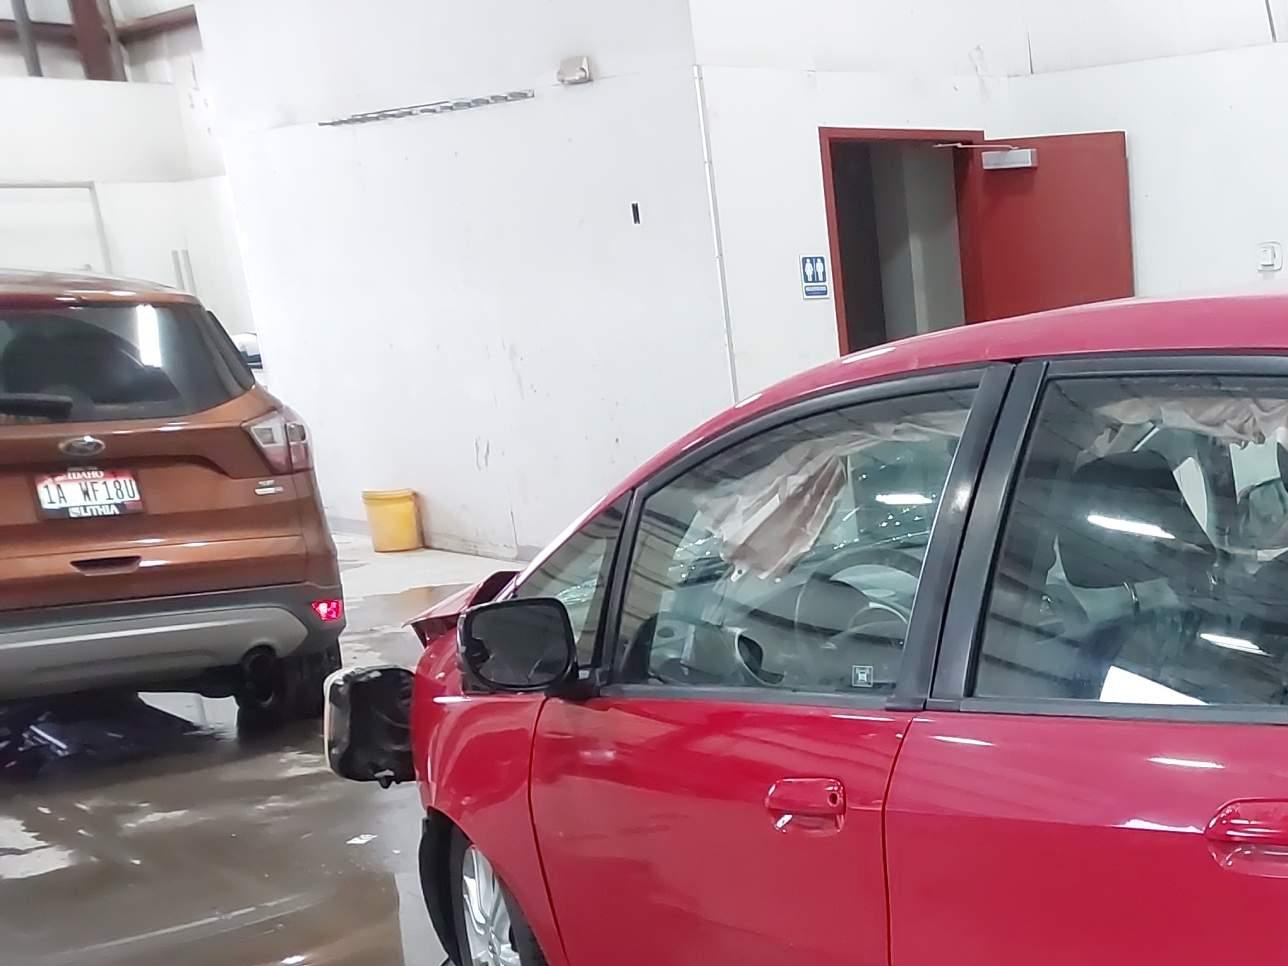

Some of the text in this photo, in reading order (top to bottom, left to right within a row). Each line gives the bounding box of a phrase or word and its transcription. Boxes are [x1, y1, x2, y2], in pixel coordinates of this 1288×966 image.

[67, 470, 105, 480] IDAHO
[43, 479, 136, 505] 1A WF18U
